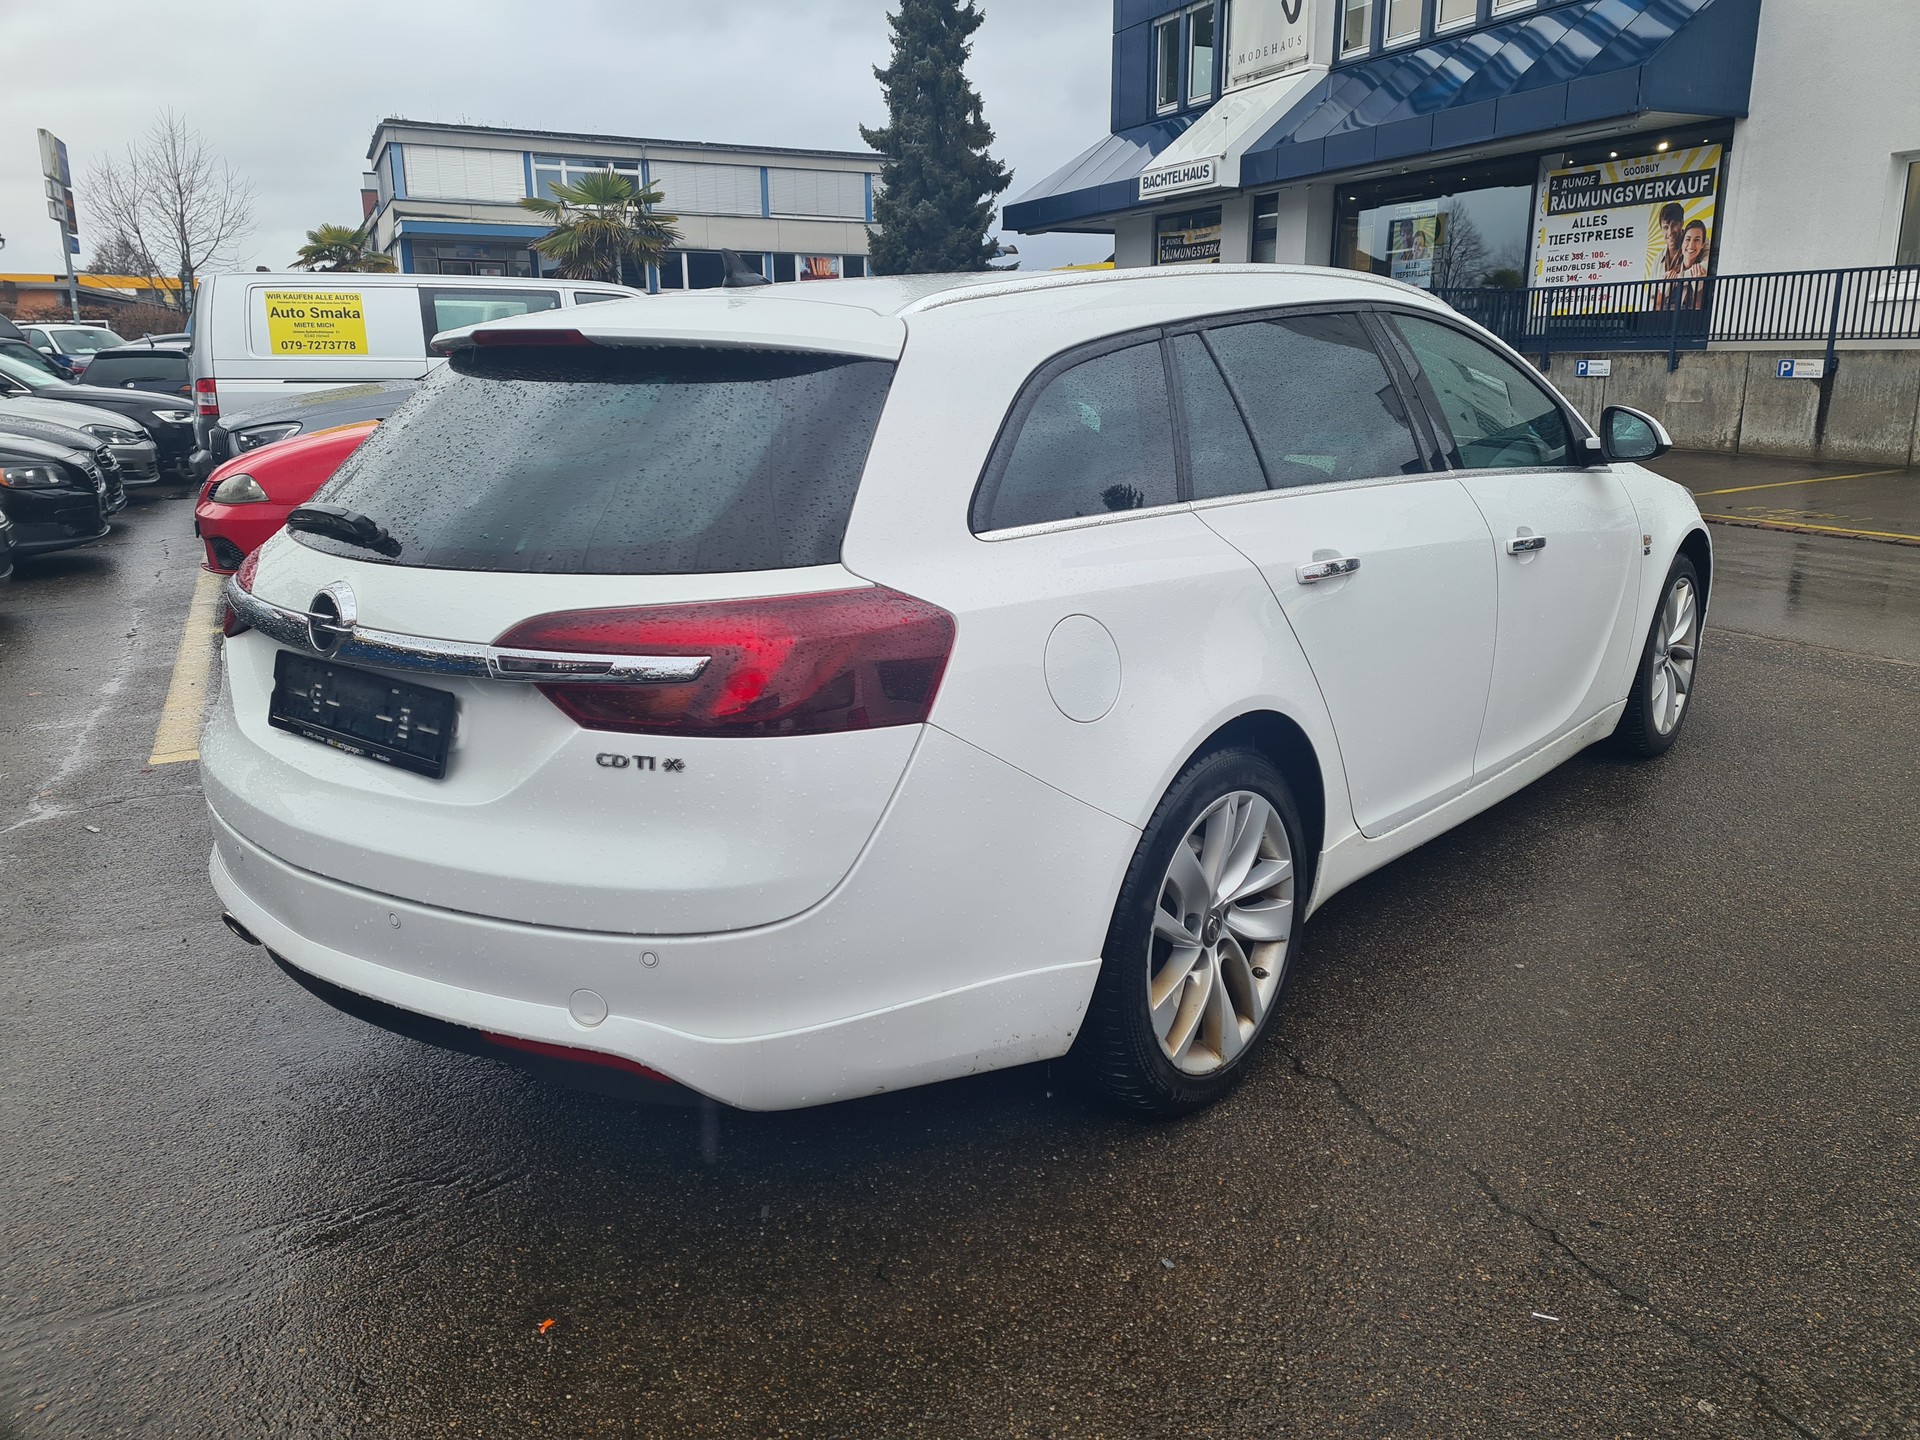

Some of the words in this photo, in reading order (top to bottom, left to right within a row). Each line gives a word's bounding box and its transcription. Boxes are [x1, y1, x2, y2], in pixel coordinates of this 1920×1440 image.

[1237, 35, 1302, 66] MODEHAUS
[1142, 164, 1210, 190] BACHTELHAUS
[1623, 163, 1661, 177] GOODBUY
[1551, 181, 1559, 191] 2.
[1562, 175, 1597, 189] RUNDE
[1550, 174, 1711, 212] RÄUMUNGSVERKAUF
[1572, 215, 1608, 229] ALLES
[1548, 226, 1634, 246] TIEFSTPREISE
[1547, 254, 1570, 263] JACKE
[1591, 251, 1609, 259] 100.-
[1618, 260, 1633, 268] 40.-
[1545, 275, 1564, 283] HOSE
[270, 306, 305, 319] Auto
[309, 306, 361, 319] Smaka
[281, 340, 356, 350] 079-7273778
[595, 752, 657, 772] CDTI
